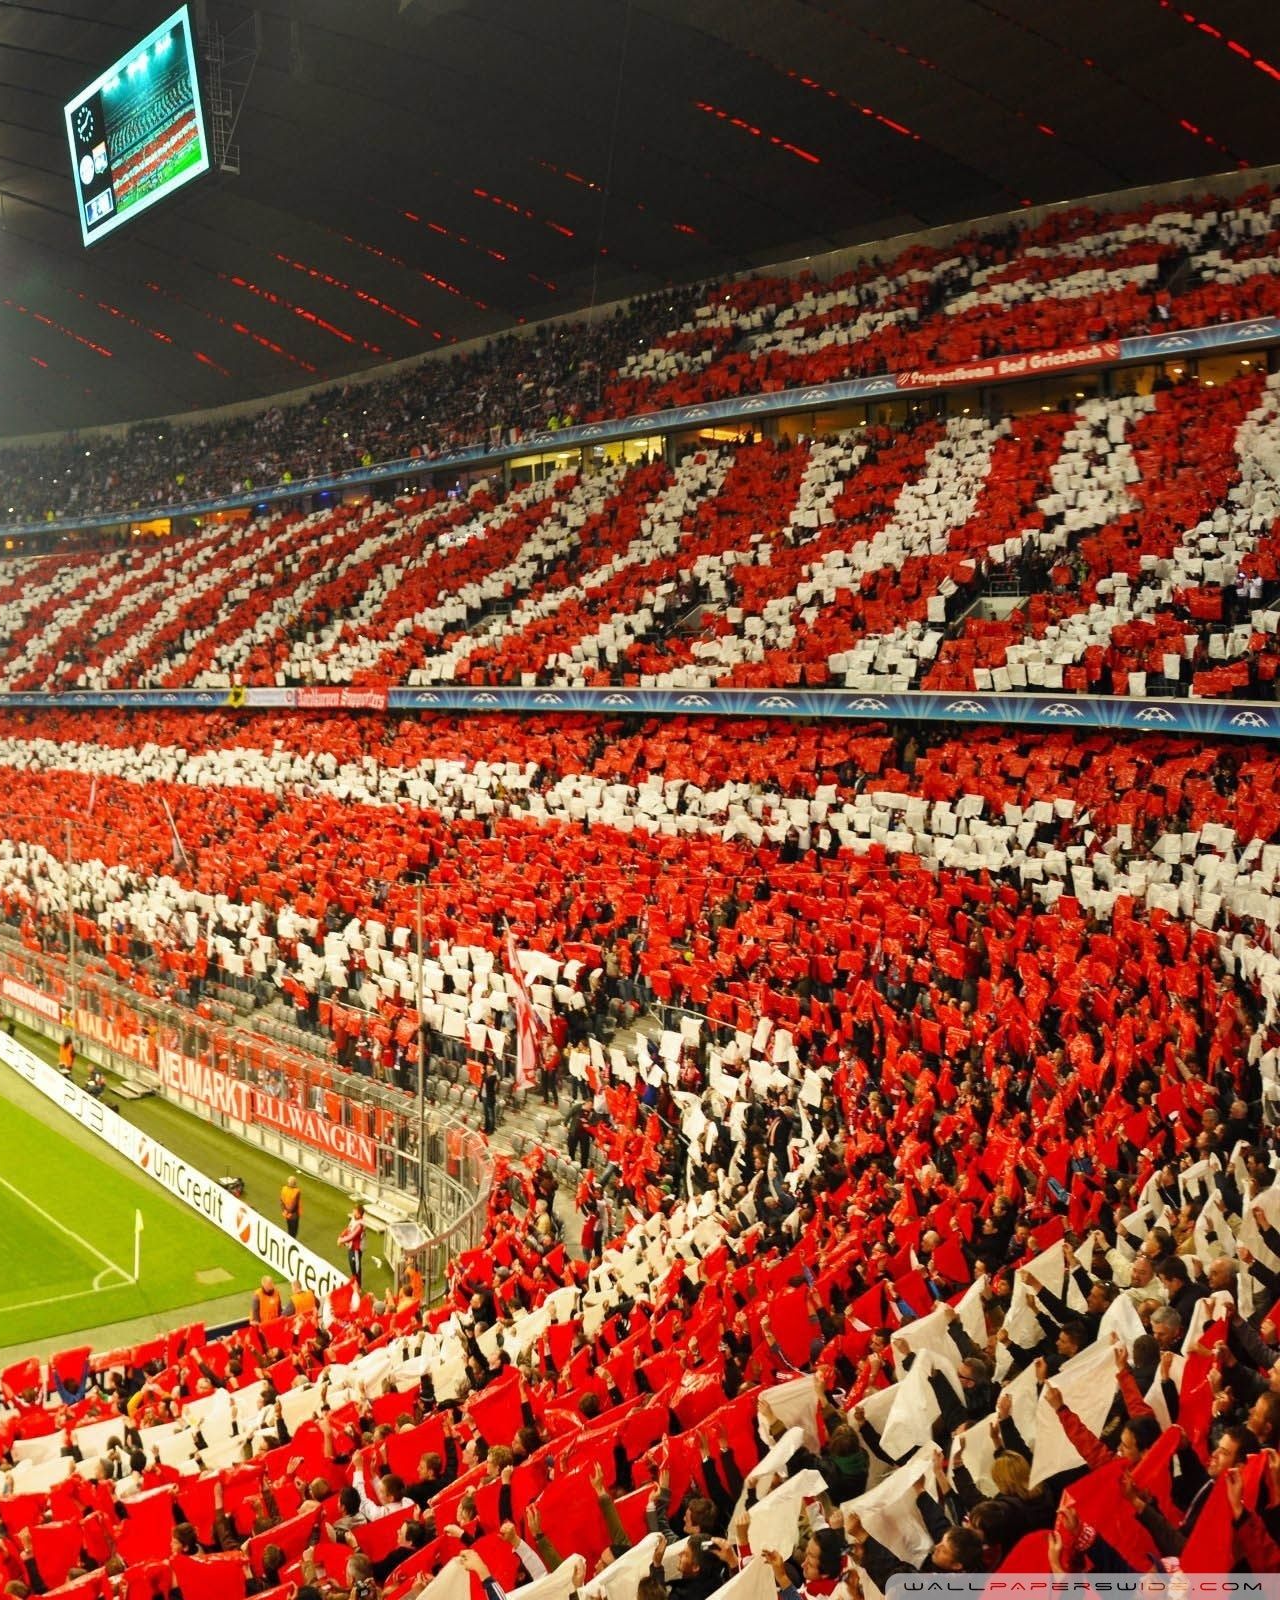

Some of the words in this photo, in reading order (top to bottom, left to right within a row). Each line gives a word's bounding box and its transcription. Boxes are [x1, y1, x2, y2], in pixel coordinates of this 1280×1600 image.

[999, 357, 1026, 374] Bad
[1030, 344, 1102, 369] Griesbach
[159, 1046, 251, 1123] NEUMARKT
[255, 1092, 375, 1166] ELLWANGEN
[152, 1146, 223, 1224] UniCredit
